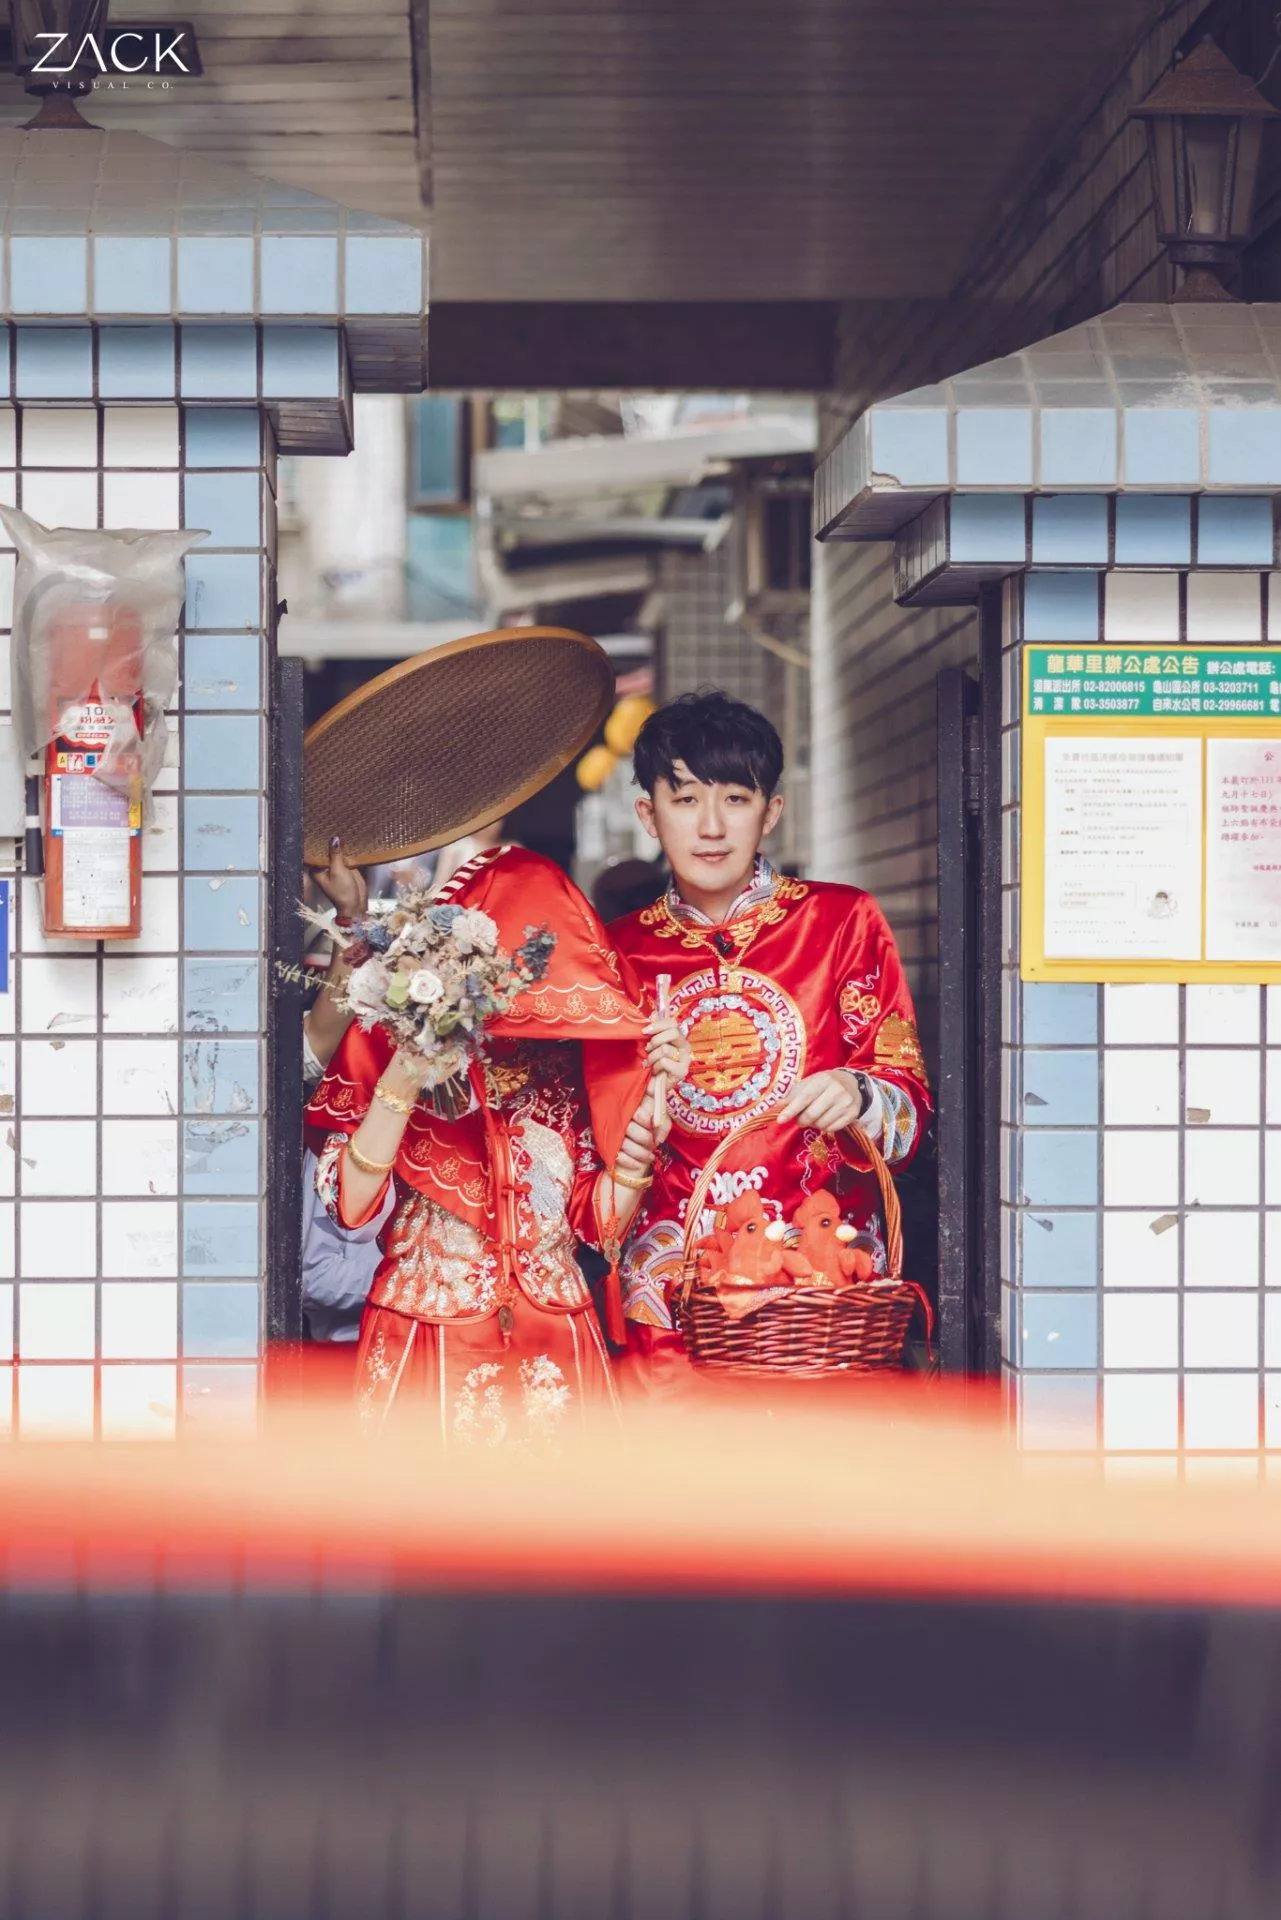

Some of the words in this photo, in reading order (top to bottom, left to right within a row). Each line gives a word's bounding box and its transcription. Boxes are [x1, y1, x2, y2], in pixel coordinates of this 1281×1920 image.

[1047, 655, 1199, 674] 龍華里辦公處公告
[1083, 681, 1145, 692] 02-82006815
[1203, 682, 1258, 693] 03-3203711
